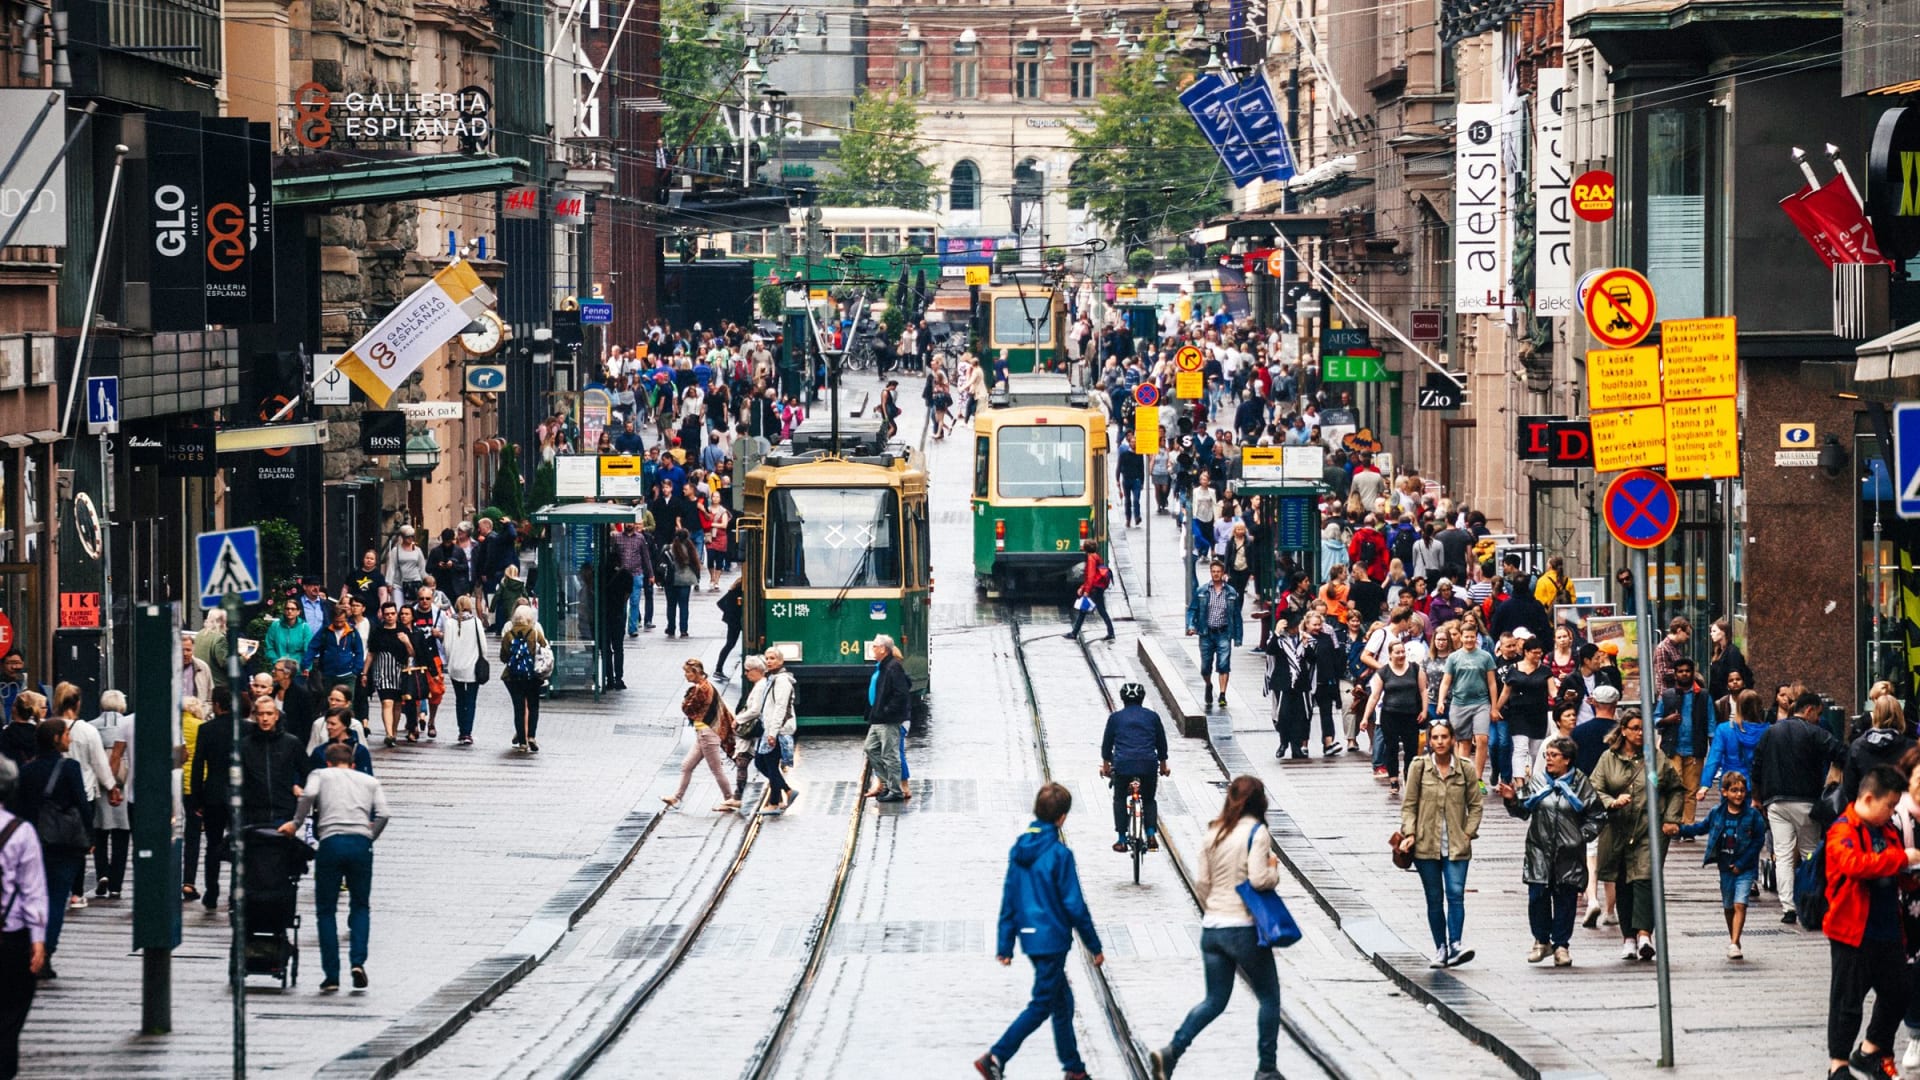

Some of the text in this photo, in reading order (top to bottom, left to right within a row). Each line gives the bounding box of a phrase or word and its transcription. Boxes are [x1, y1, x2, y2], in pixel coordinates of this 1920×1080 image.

[345, 92, 486, 112] GALLERIA
[346, 117, 487, 136] ESPLANAD
[1575, 184, 1614, 201] RAX
[155, 184, 186, 257] GLO
[191, 204, 199, 235] HOTEL
[1460, 152, 1497, 272] aleksi
[387, 295, 441, 341] GALLERIA
[583, 306, 610, 315] Fenno
[391, 301, 446, 347] ESPLANAD
[1420, 390, 1451, 407] Zio
[370, 436, 401, 446] BOSS
[1055, 539, 1070, 551] 97
[840, 640, 860, 655] 84
